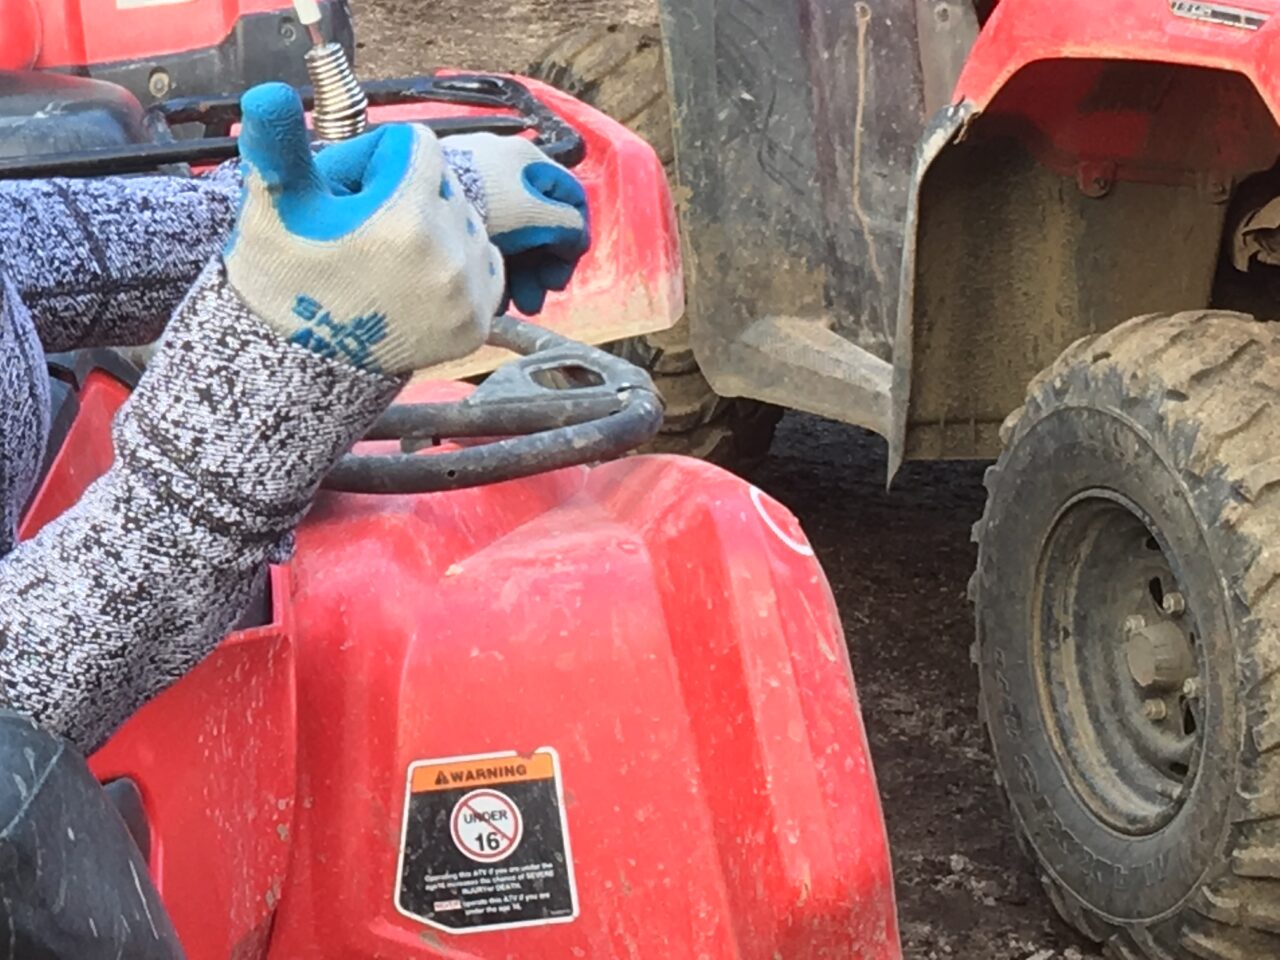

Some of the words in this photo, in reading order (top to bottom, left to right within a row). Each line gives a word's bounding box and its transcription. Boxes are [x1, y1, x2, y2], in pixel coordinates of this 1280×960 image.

[451, 764, 527, 783] WARNING
[463, 809, 508, 825] UNDER
[475, 832, 500, 852] 16
